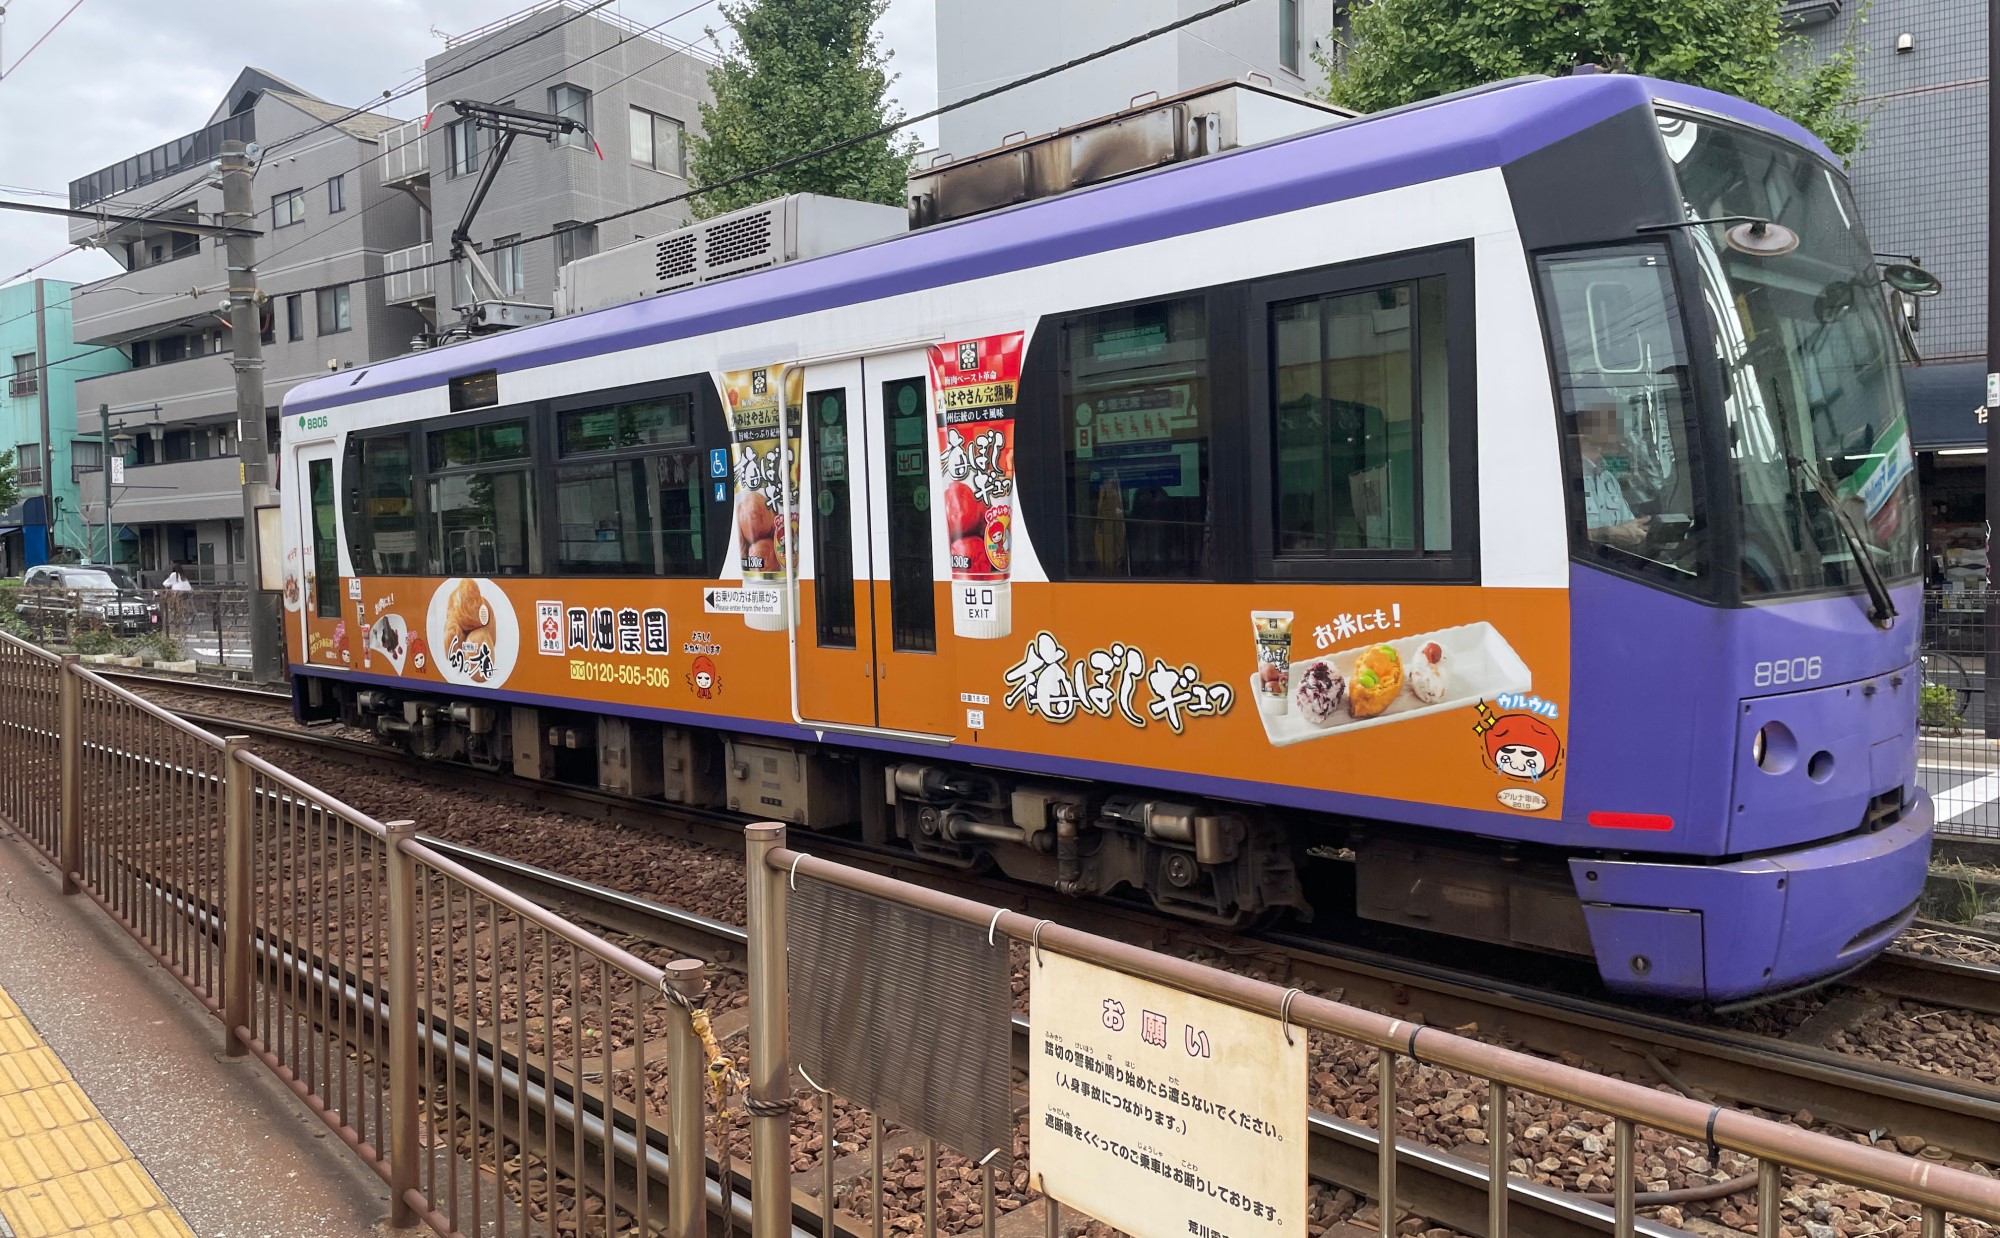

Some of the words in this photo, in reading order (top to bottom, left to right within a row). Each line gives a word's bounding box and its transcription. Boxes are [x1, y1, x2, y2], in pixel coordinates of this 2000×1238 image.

[307, 415, 328, 430] 8806
[946, 407, 1005, 423] 州伝統のしそ風味
[715, 590, 779, 604] お乗りの方は前扉から
[715, 603, 730, 612] Please
[762, 605, 774, 613] front
[964, 587, 993, 605] 出口
[968, 608, 990, 619] EXIT
[1312, 603, 1401, 650] お米にも!
[567, 608, 669, 654] 岡畑農園
[586, 661, 670, 688] 0120-505-506
[1754, 655, 1822, 687] 8806
[1497, 693, 1559, 718] ウルウル
[1102, 998, 1211, 1059] お願い
[1044, 1040, 1283, 1142] 踏切の警報が鳴り始めたら渡らないでください。
[1044, 1112, 1283, 1225] 遮断機をくぐってのご乗車はお断りしております。
